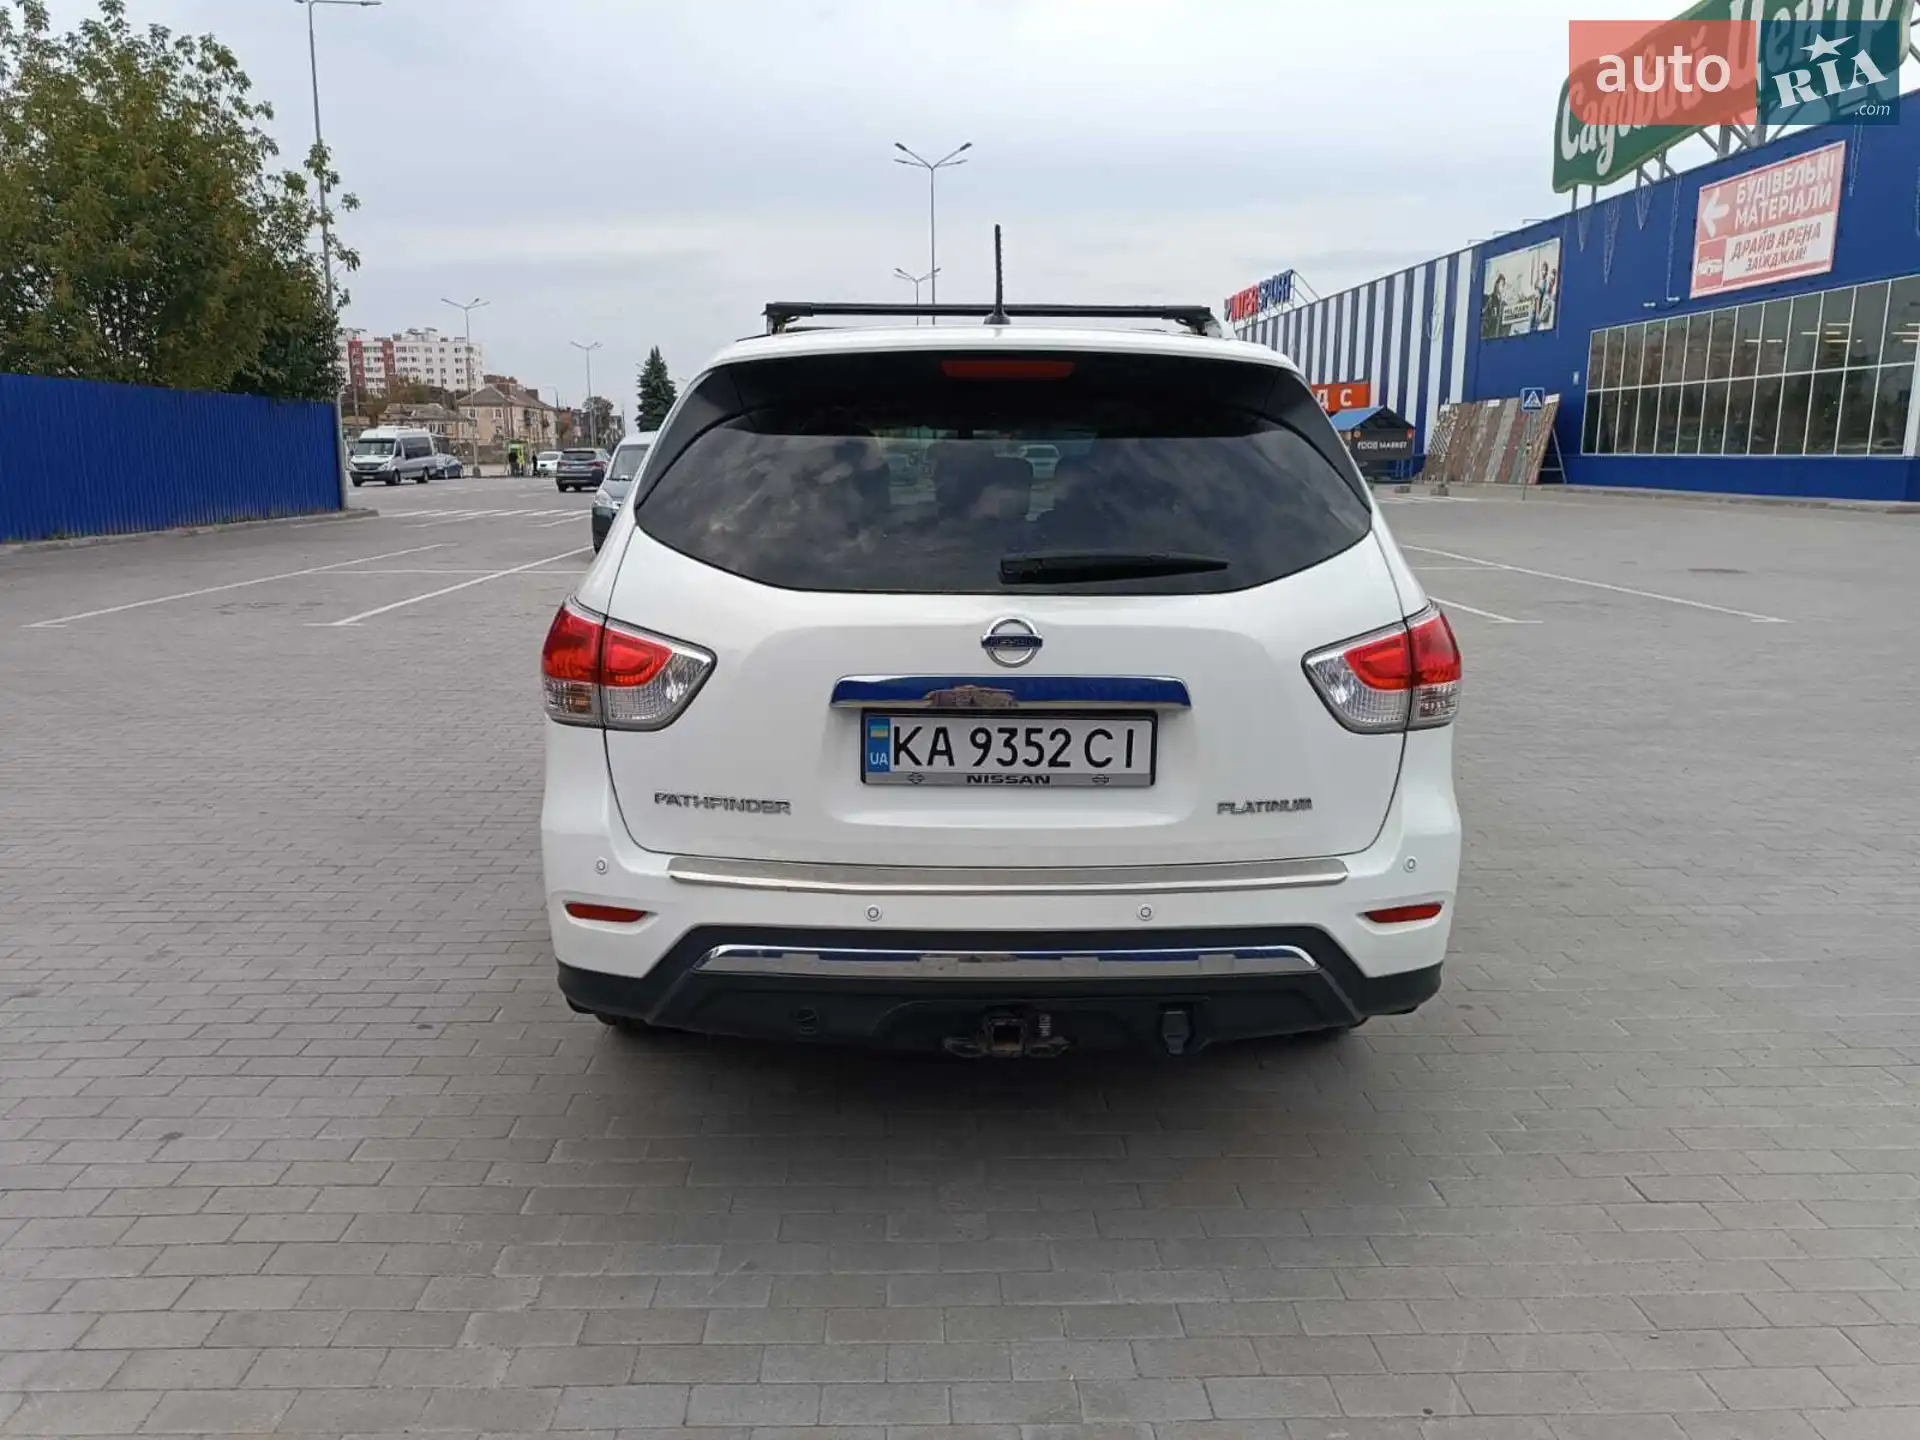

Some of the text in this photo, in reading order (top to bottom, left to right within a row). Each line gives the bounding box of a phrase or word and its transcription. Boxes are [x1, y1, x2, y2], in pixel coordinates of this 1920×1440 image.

[1736, 152, 1836, 204] БУДІВЕЛЬНІ
[1734, 182, 1832, 231] МАТЕРІАЛИ
[1776, 221, 1822, 249] АРЕНА
[870, 752, 888, 765] UA
[893, 726, 1134, 769] KA 9352 CI
[966, 774, 1050, 785] NISSAN
[654, 792, 791, 815] PATHFINDER
[1217, 798, 1313, 815] PLATINUM
